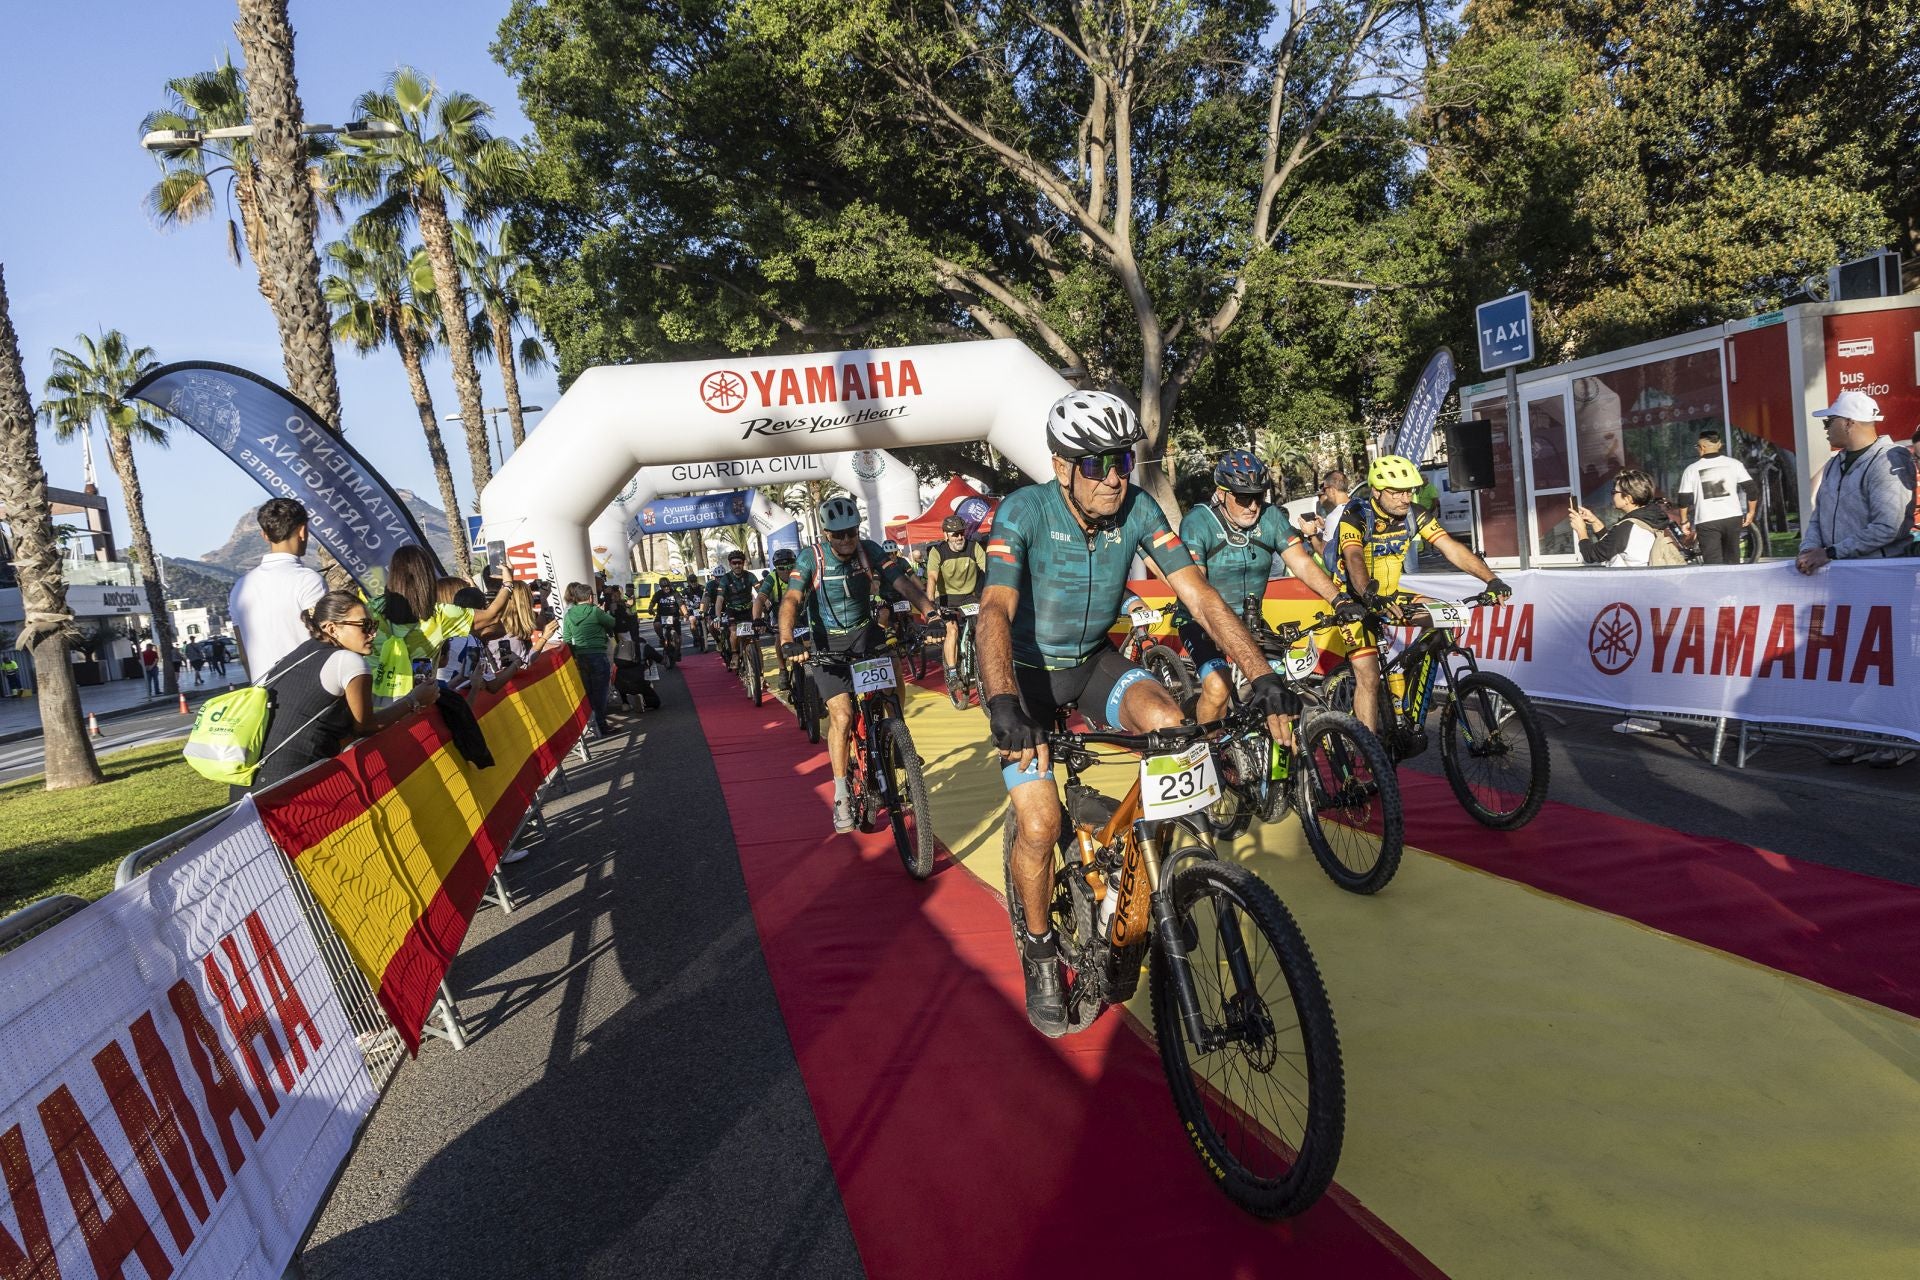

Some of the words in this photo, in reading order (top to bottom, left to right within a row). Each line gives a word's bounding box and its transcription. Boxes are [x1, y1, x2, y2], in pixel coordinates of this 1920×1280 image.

[1482, 319, 1526, 346] TAXI
[750, 359, 922, 407] YAMAHA
[1840, 372, 1865, 385] bus
[740, 417, 807, 440] Revs
[808, 412, 856, 433] Your
[855, 405, 908, 423] Heart
[1406, 394, 1432, 459] RTAGENA
[671, 459, 764, 481] GUARDIA
[769, 455, 818, 473] CIVIL
[663, 500, 725, 515] Ayuntamiento
[663, 510, 725, 526] Cartagena
[1050, 531, 1071, 542] GOBIK
[1442, 608, 1459, 620] 52
[1650, 604, 1894, 686] YAMAHA
[861, 667, 888, 684] 250
[1109, 670, 1145, 705] TEAM
[1412, 651, 1431, 723] STEVENS
[1159, 763, 1205, 801] 237
[1186, 1120, 1226, 1179] MAXXIS
